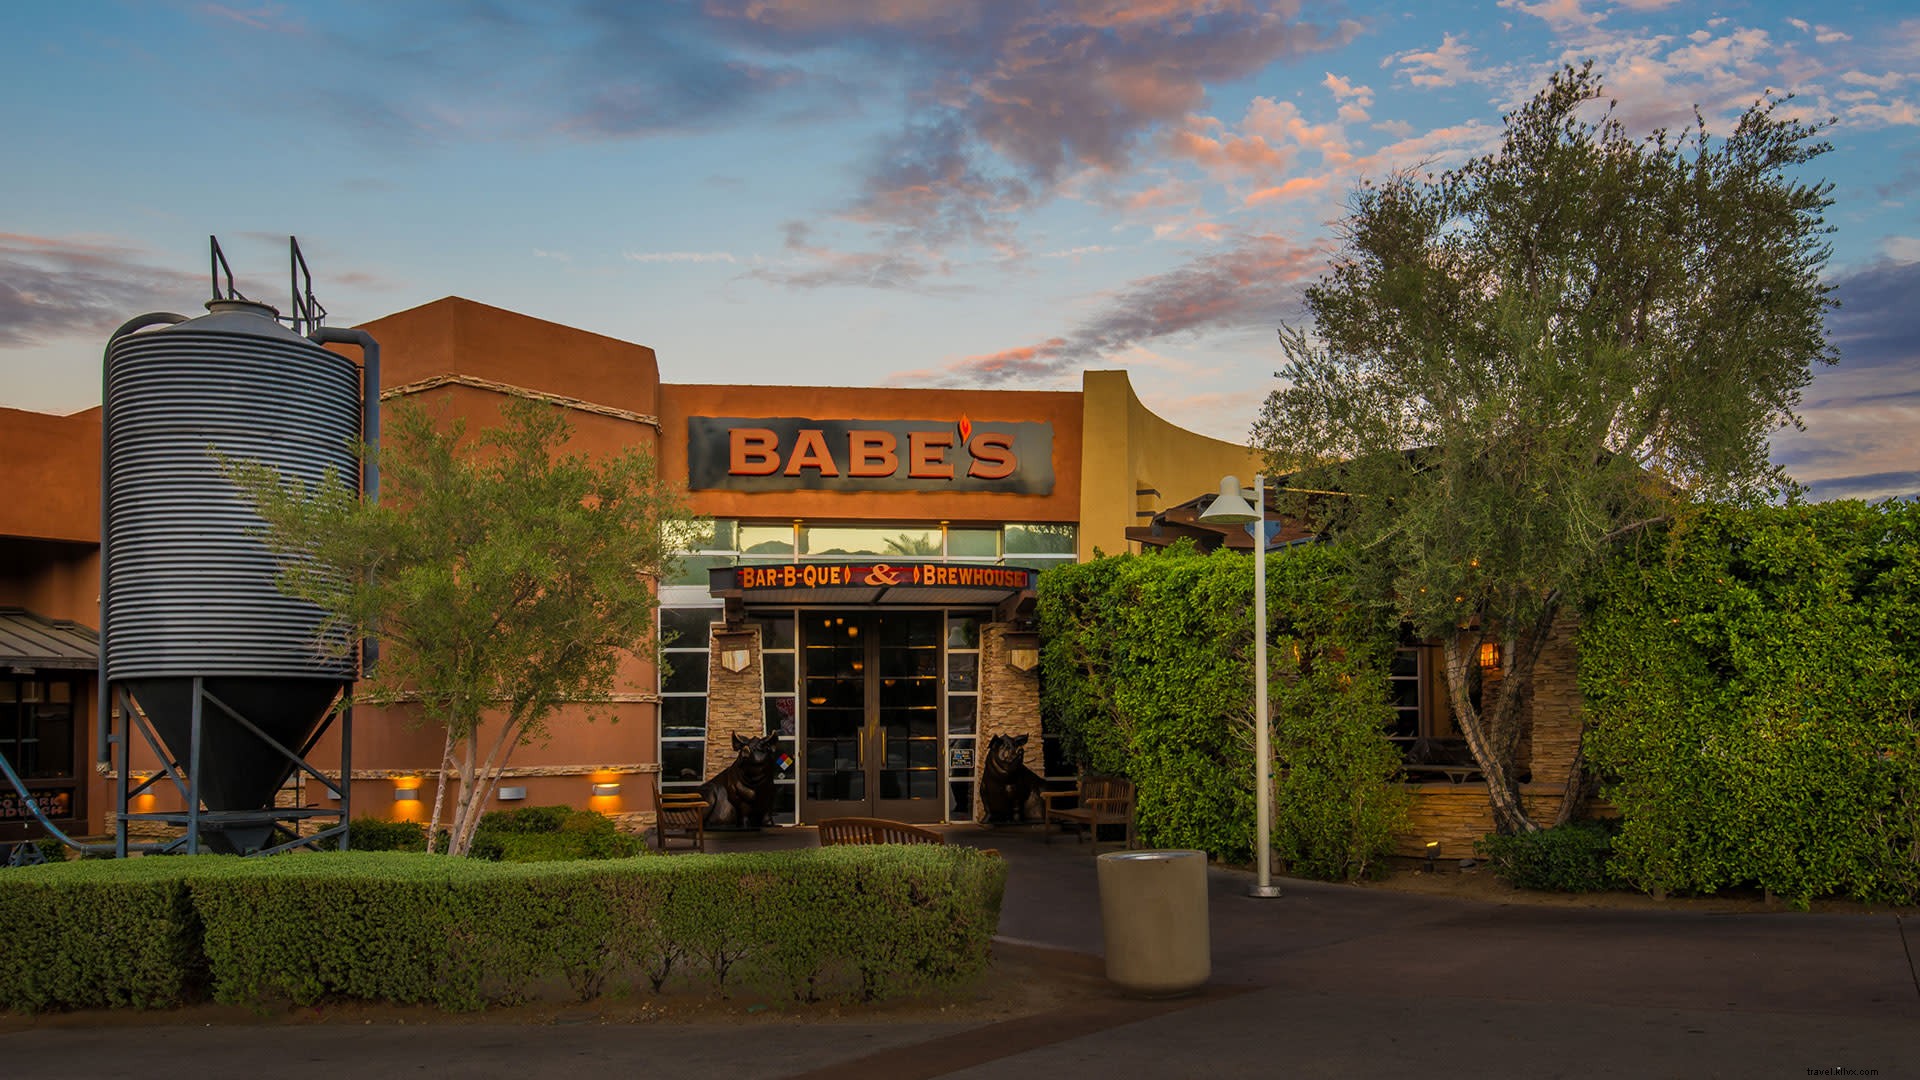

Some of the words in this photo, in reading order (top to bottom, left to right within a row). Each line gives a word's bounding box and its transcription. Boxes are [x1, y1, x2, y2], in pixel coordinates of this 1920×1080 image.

[727, 413, 1018, 480] BABE'S
[743, 565, 841, 588] BAR-B-QUE
[863, 564, 901, 587] &
[923, 564, 1023, 587] BREWHOUSE
